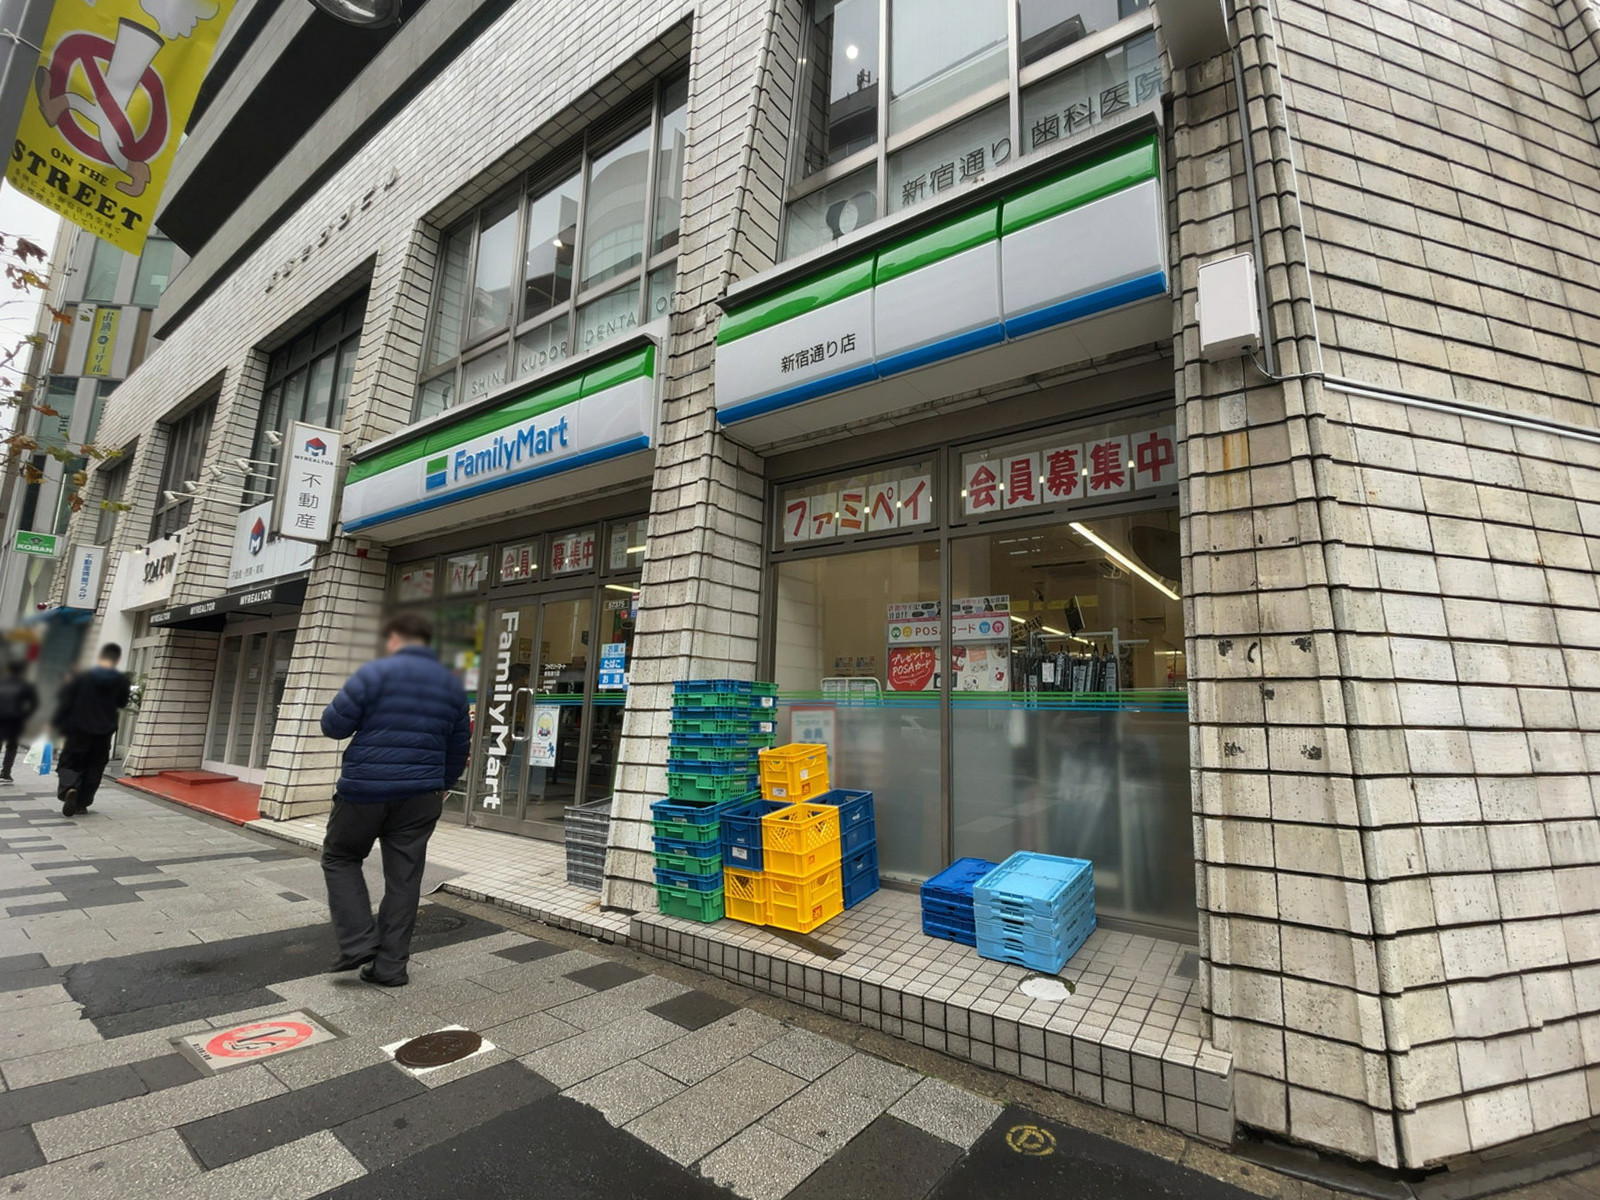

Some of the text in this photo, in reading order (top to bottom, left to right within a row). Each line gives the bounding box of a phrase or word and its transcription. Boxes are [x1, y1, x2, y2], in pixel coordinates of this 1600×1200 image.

[901, 66, 1164, 206] 新宿通り 歯科医院
[12, 139, 143, 231] STREET
[50, 147, 109, 187] ON THE
[780, 333, 856, 373] 新宿通り店
[294, 454, 334, 466] MYREALTOR
[454, 416, 569, 481] FamilyMart
[294, 472, 323, 530] 不動産
[786, 432, 1174, 537] ファミペイ 会員募集中
[17, 543, 53, 554] KOBAN
[239, 589, 273, 606] MYREALTOR
[603, 659, 621, 669] たばこ
[483, 610, 520, 810] FamilyMart
